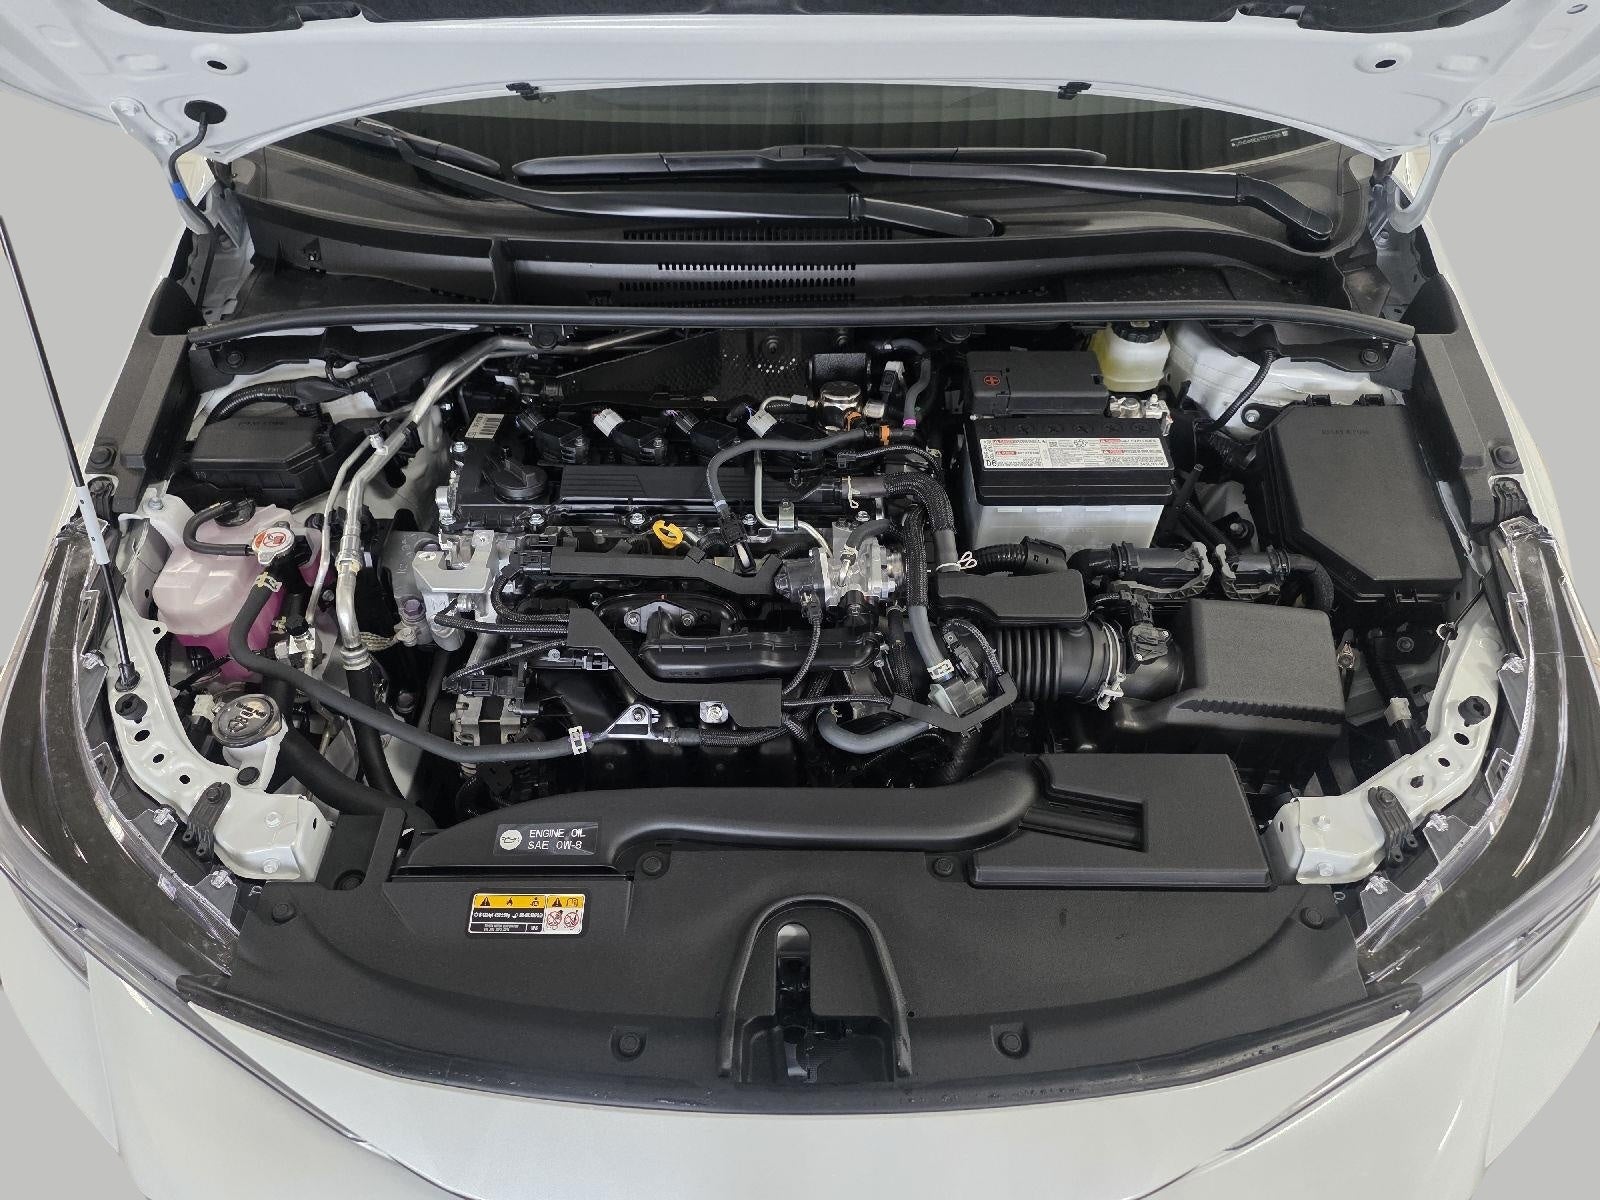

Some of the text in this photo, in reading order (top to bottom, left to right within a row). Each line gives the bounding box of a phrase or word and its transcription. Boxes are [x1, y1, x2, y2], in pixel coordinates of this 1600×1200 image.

[529, 829, 586, 838] ENGINE OIL
[527, 841, 549, 850] SAE
